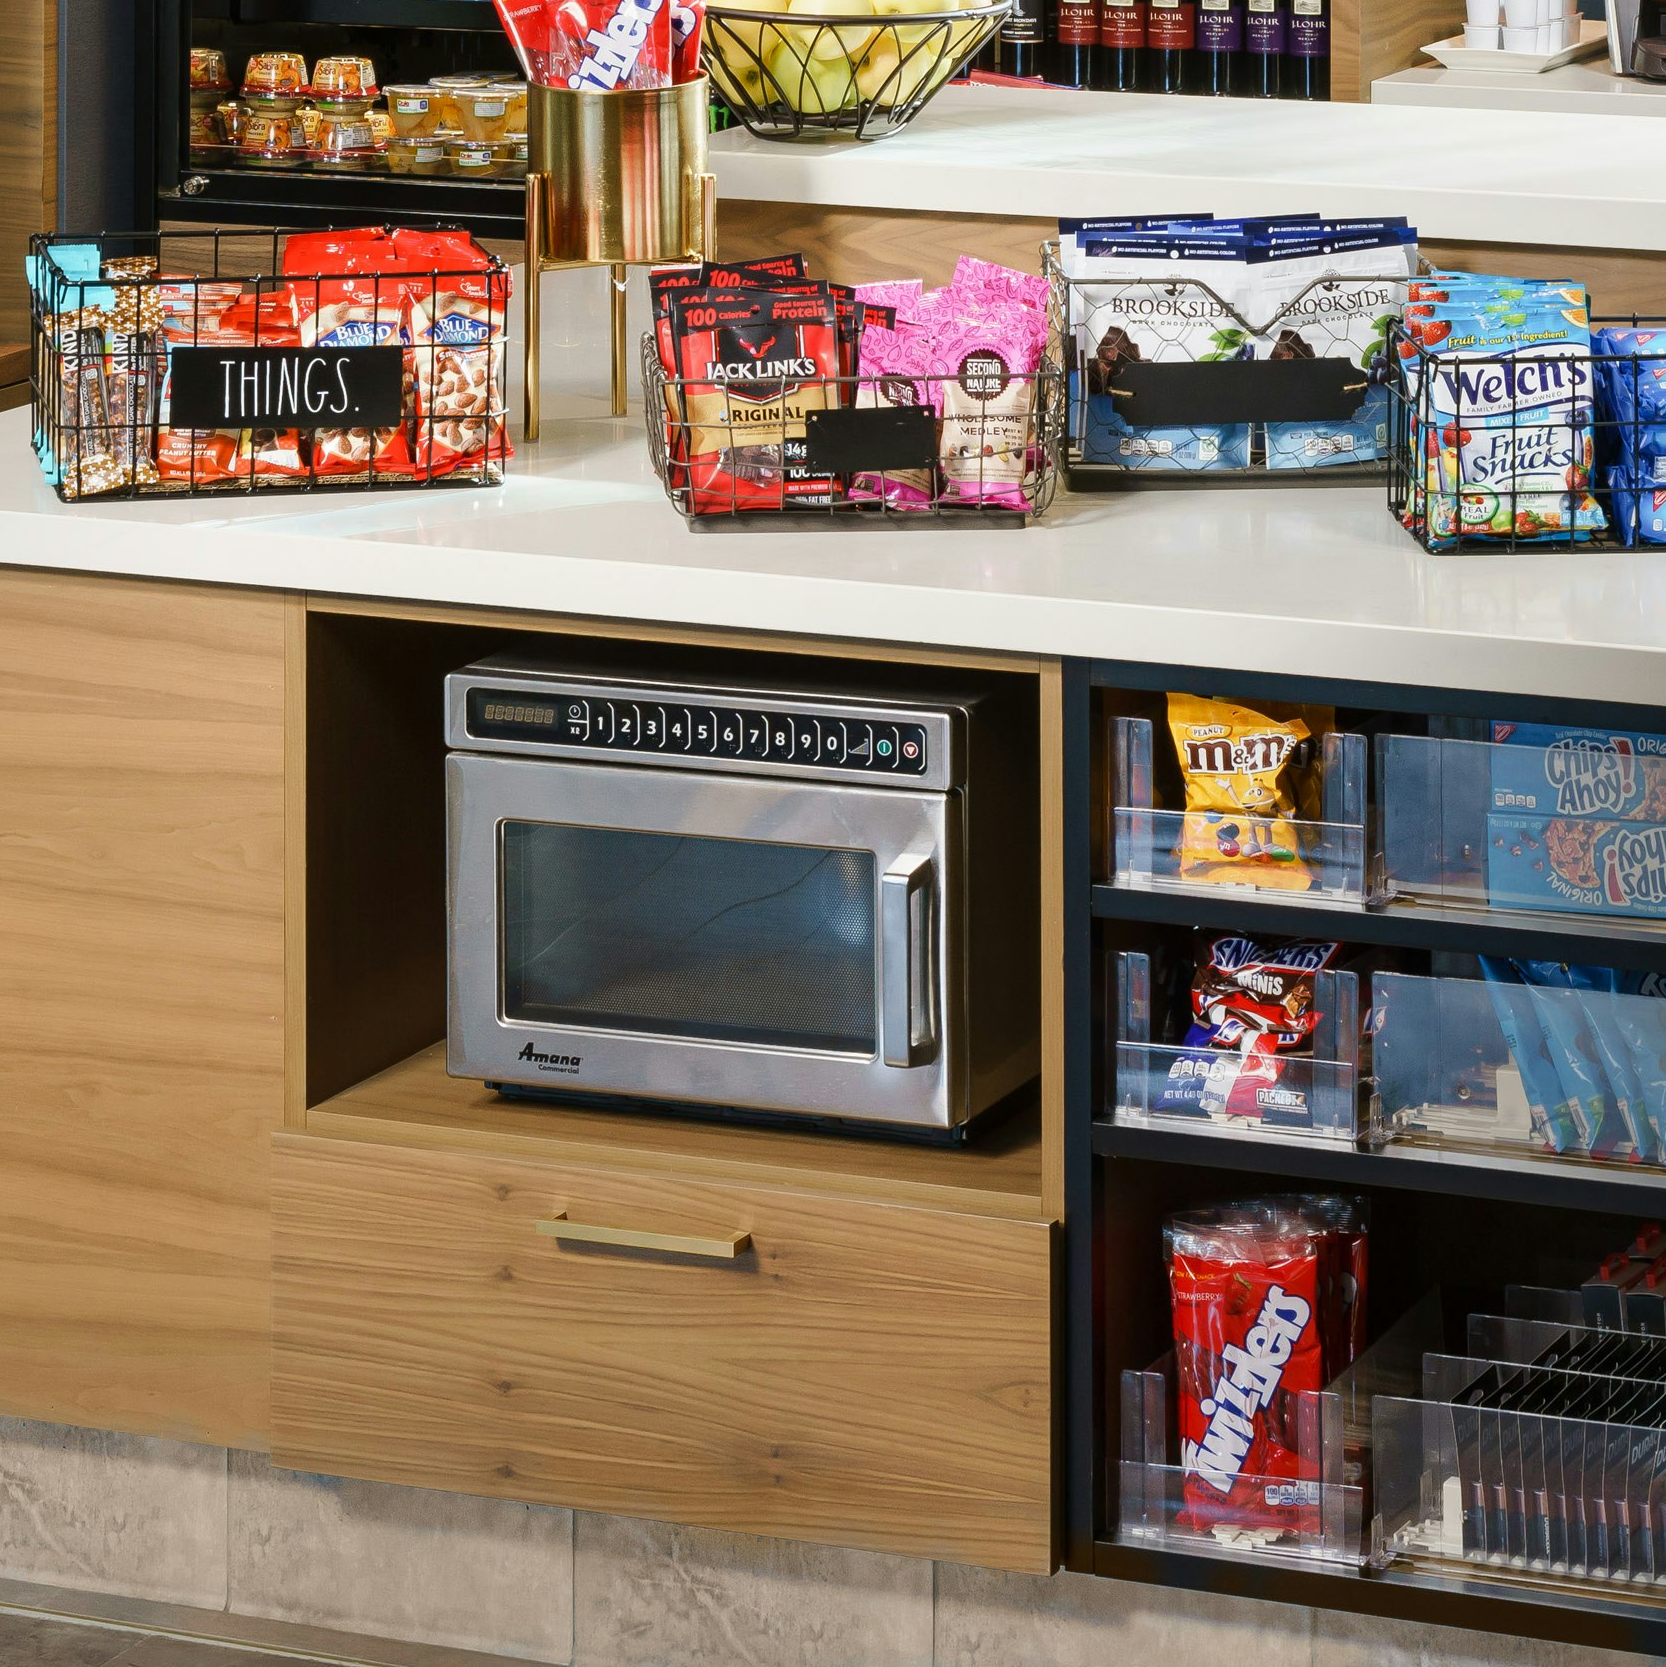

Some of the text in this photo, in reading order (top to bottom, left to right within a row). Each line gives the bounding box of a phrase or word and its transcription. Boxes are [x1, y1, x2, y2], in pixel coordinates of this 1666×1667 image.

[772, 305, 827, 319] Protein
[1112, 298, 1236, 317] BROOKSIDE
[1280, 289, 1390, 317] BROOKSIDE
[441, 318, 472, 333] BLUE
[685, 308, 751, 326] 100 Calories
[336, 320, 373, 338] BLUE
[1448, 335, 1475, 349] Fruit
[1521, 330, 1567, 342] Ingredient!
[61, 329, 78, 373] KIND
[112, 331, 130, 374] KIND
[705, 357, 816, 380] JACK LINK'S
[966, 361, 1001, 375] SECOND
[220, 357, 360, 418] THINGS.
[1439, 352, 1587, 406] Welch's
[1533, 391, 1562, 403] OWNED
[948, 414, 1022, 425] WHOLESOME
[1520, 410, 1545, 422] FRUIT
[960, 425, 1008, 437] MEDLEY
[1490, 428, 1557, 461] Fruit
[1472, 447, 1572, 484] Snacks
[597, 716, 838, 751] 1 2 3 4 5 6 7 8 9 0
[1192, 725, 1225, 738] PEANUT
[1546, 740, 1618, 786] Chips
[518, 1041, 582, 1067] Amana
[537, 1063, 580, 1075] Commercial
